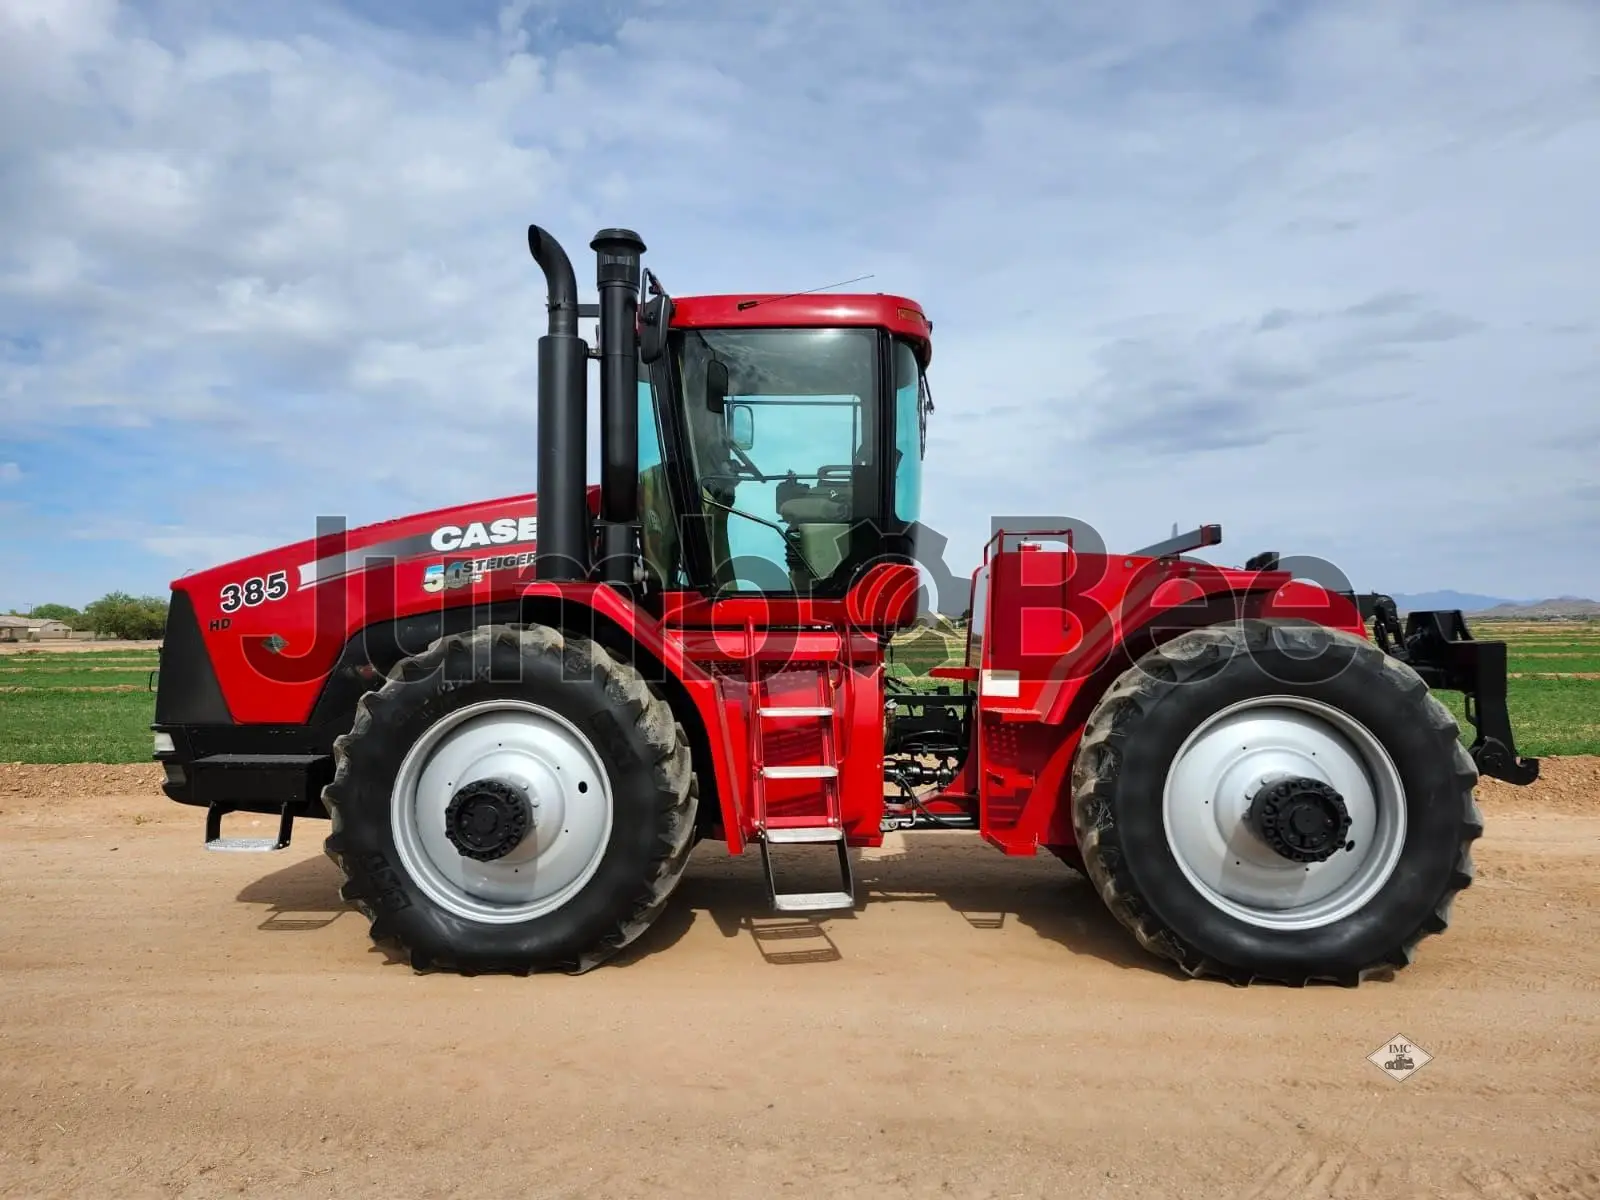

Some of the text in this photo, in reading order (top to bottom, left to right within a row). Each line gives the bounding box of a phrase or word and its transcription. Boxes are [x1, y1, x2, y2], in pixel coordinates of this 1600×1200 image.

[430, 517, 537, 551] CASE
[220, 570, 288, 613] 385
[208, 618, 232, 632] HD
